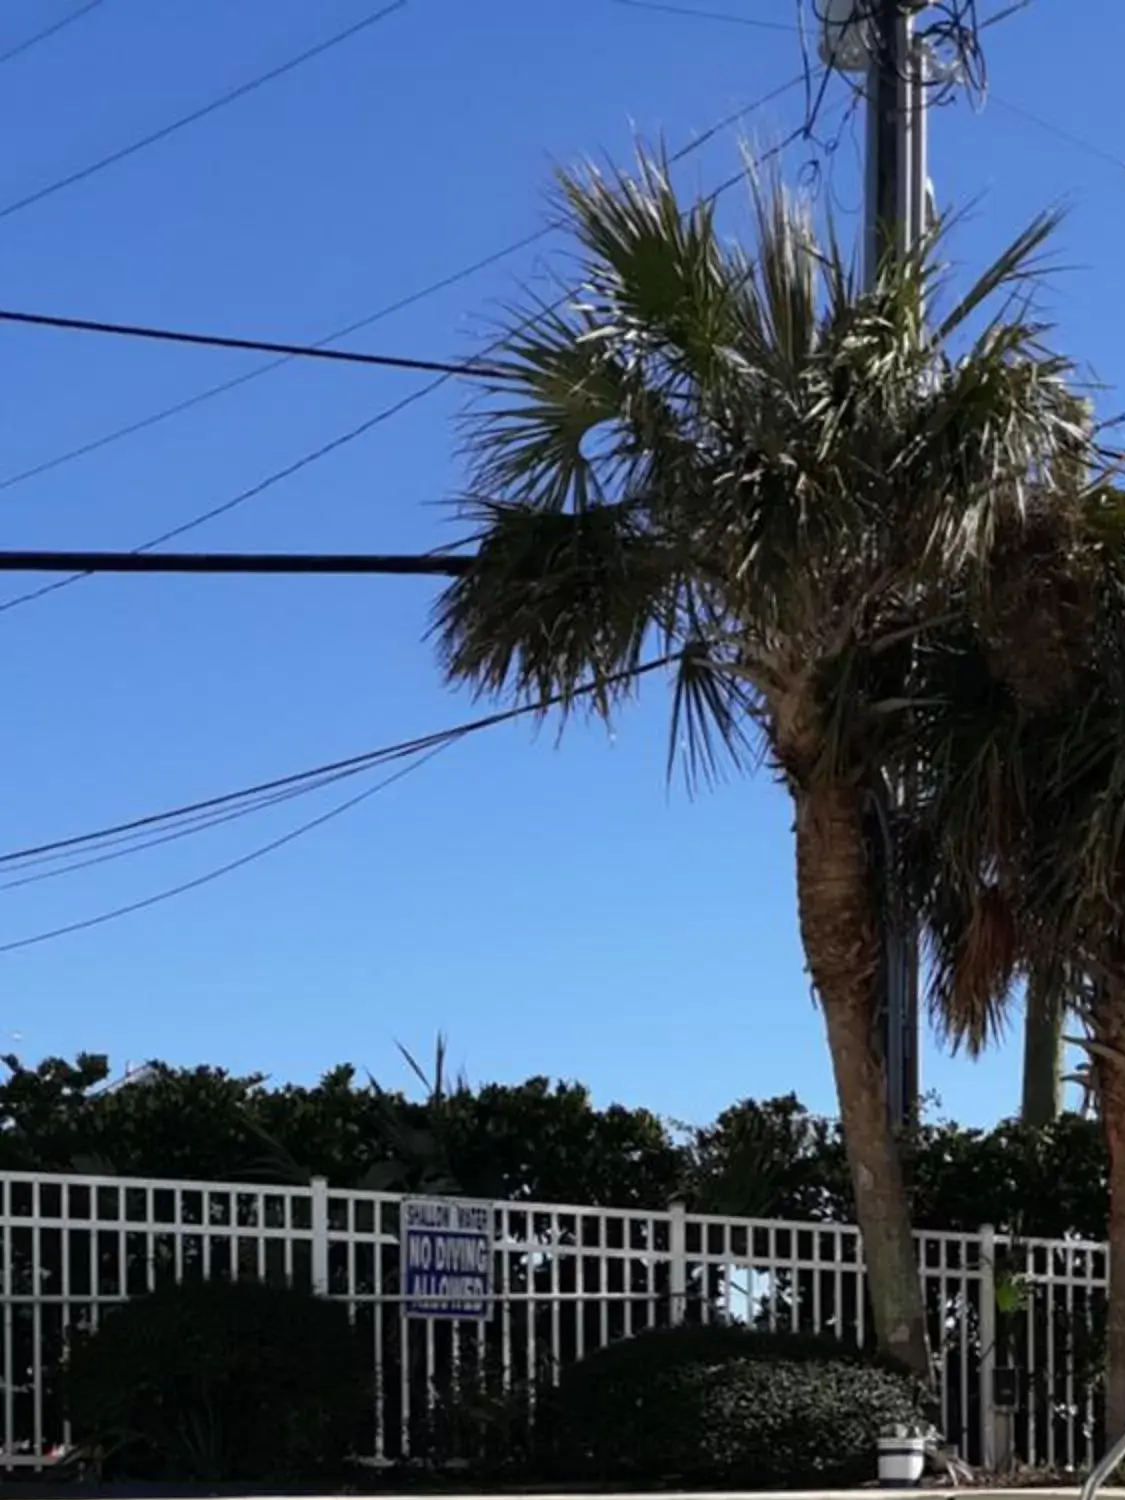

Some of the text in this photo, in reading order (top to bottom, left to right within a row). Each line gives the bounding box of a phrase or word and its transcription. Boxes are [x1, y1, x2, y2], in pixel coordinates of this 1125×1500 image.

[411, 1237, 487, 1273] NO DIVING
[413, 1276, 483, 1310] ALLOWED
